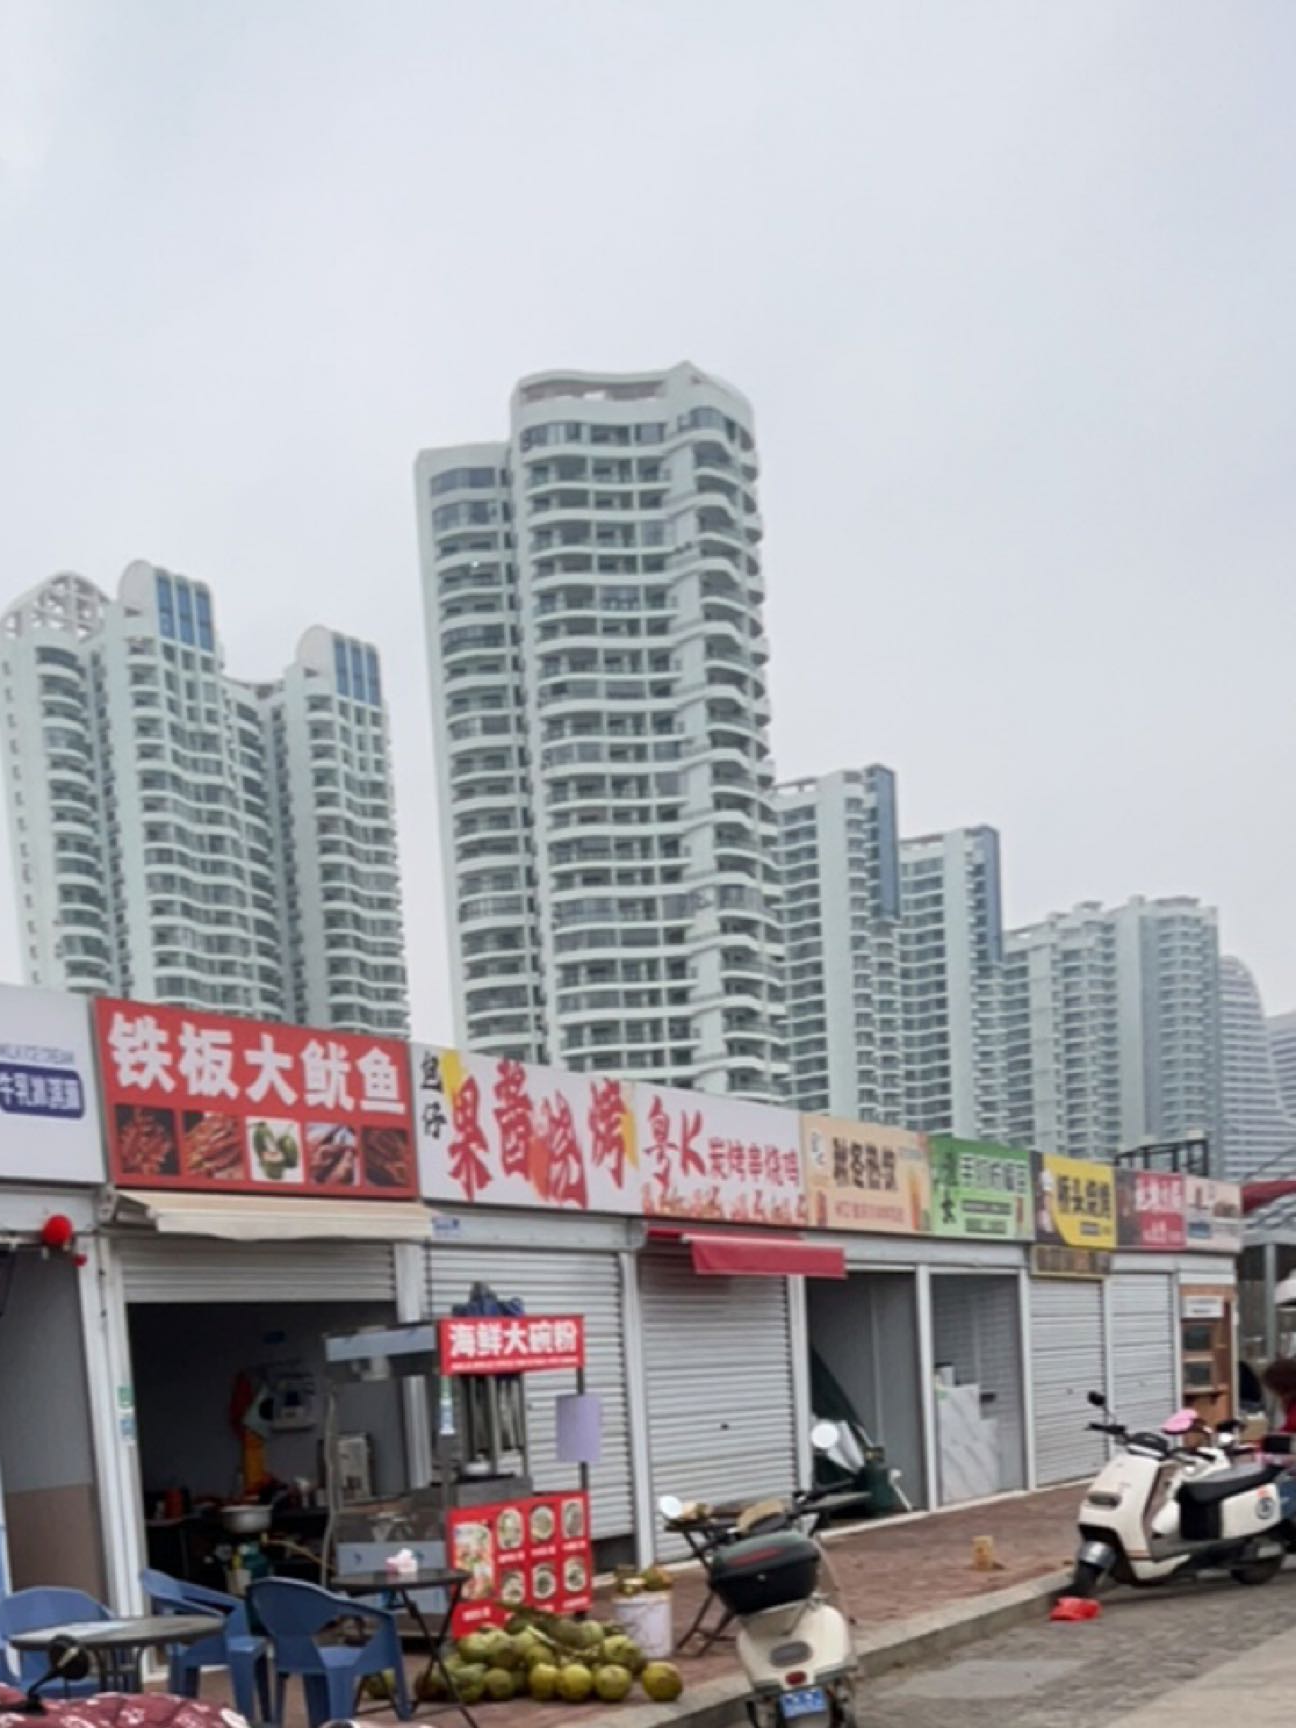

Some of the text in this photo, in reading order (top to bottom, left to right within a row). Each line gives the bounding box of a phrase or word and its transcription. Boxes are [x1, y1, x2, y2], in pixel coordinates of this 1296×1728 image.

[108, 1010, 407, 1116] 铁板大鱿鱼
